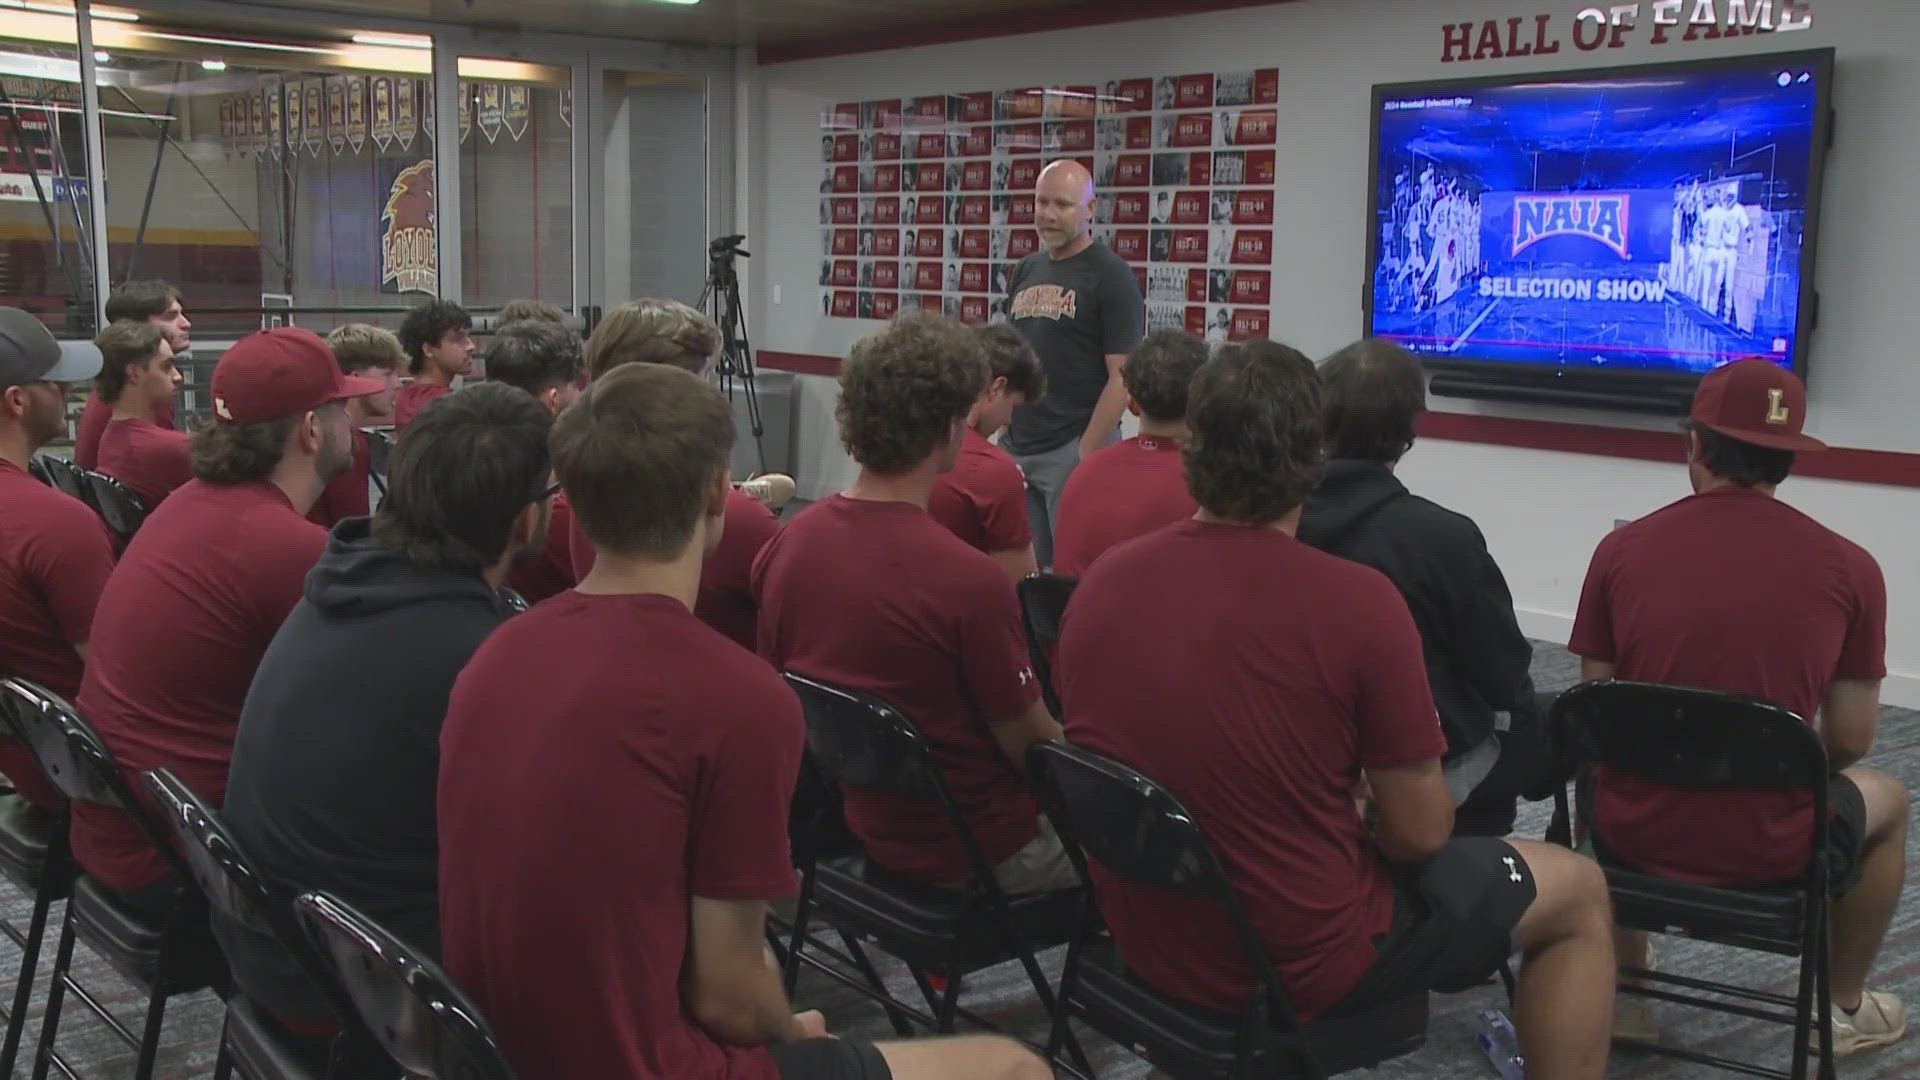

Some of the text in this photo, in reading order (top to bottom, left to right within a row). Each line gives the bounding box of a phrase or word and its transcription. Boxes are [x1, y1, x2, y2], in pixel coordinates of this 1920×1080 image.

[1441, 0, 1813, 62] HALL OF FAME
[1426, 98, 1454, 108] Selection
[1455, 97, 1472, 106] Show
[21, 121, 48, 130] GUEST
[1513, 196, 1626, 256] NAIA
[383, 228, 435, 276] LOYOL
[1478, 277, 1667, 302] SELECTION SHOW
[1765, 388, 1789, 424] L
